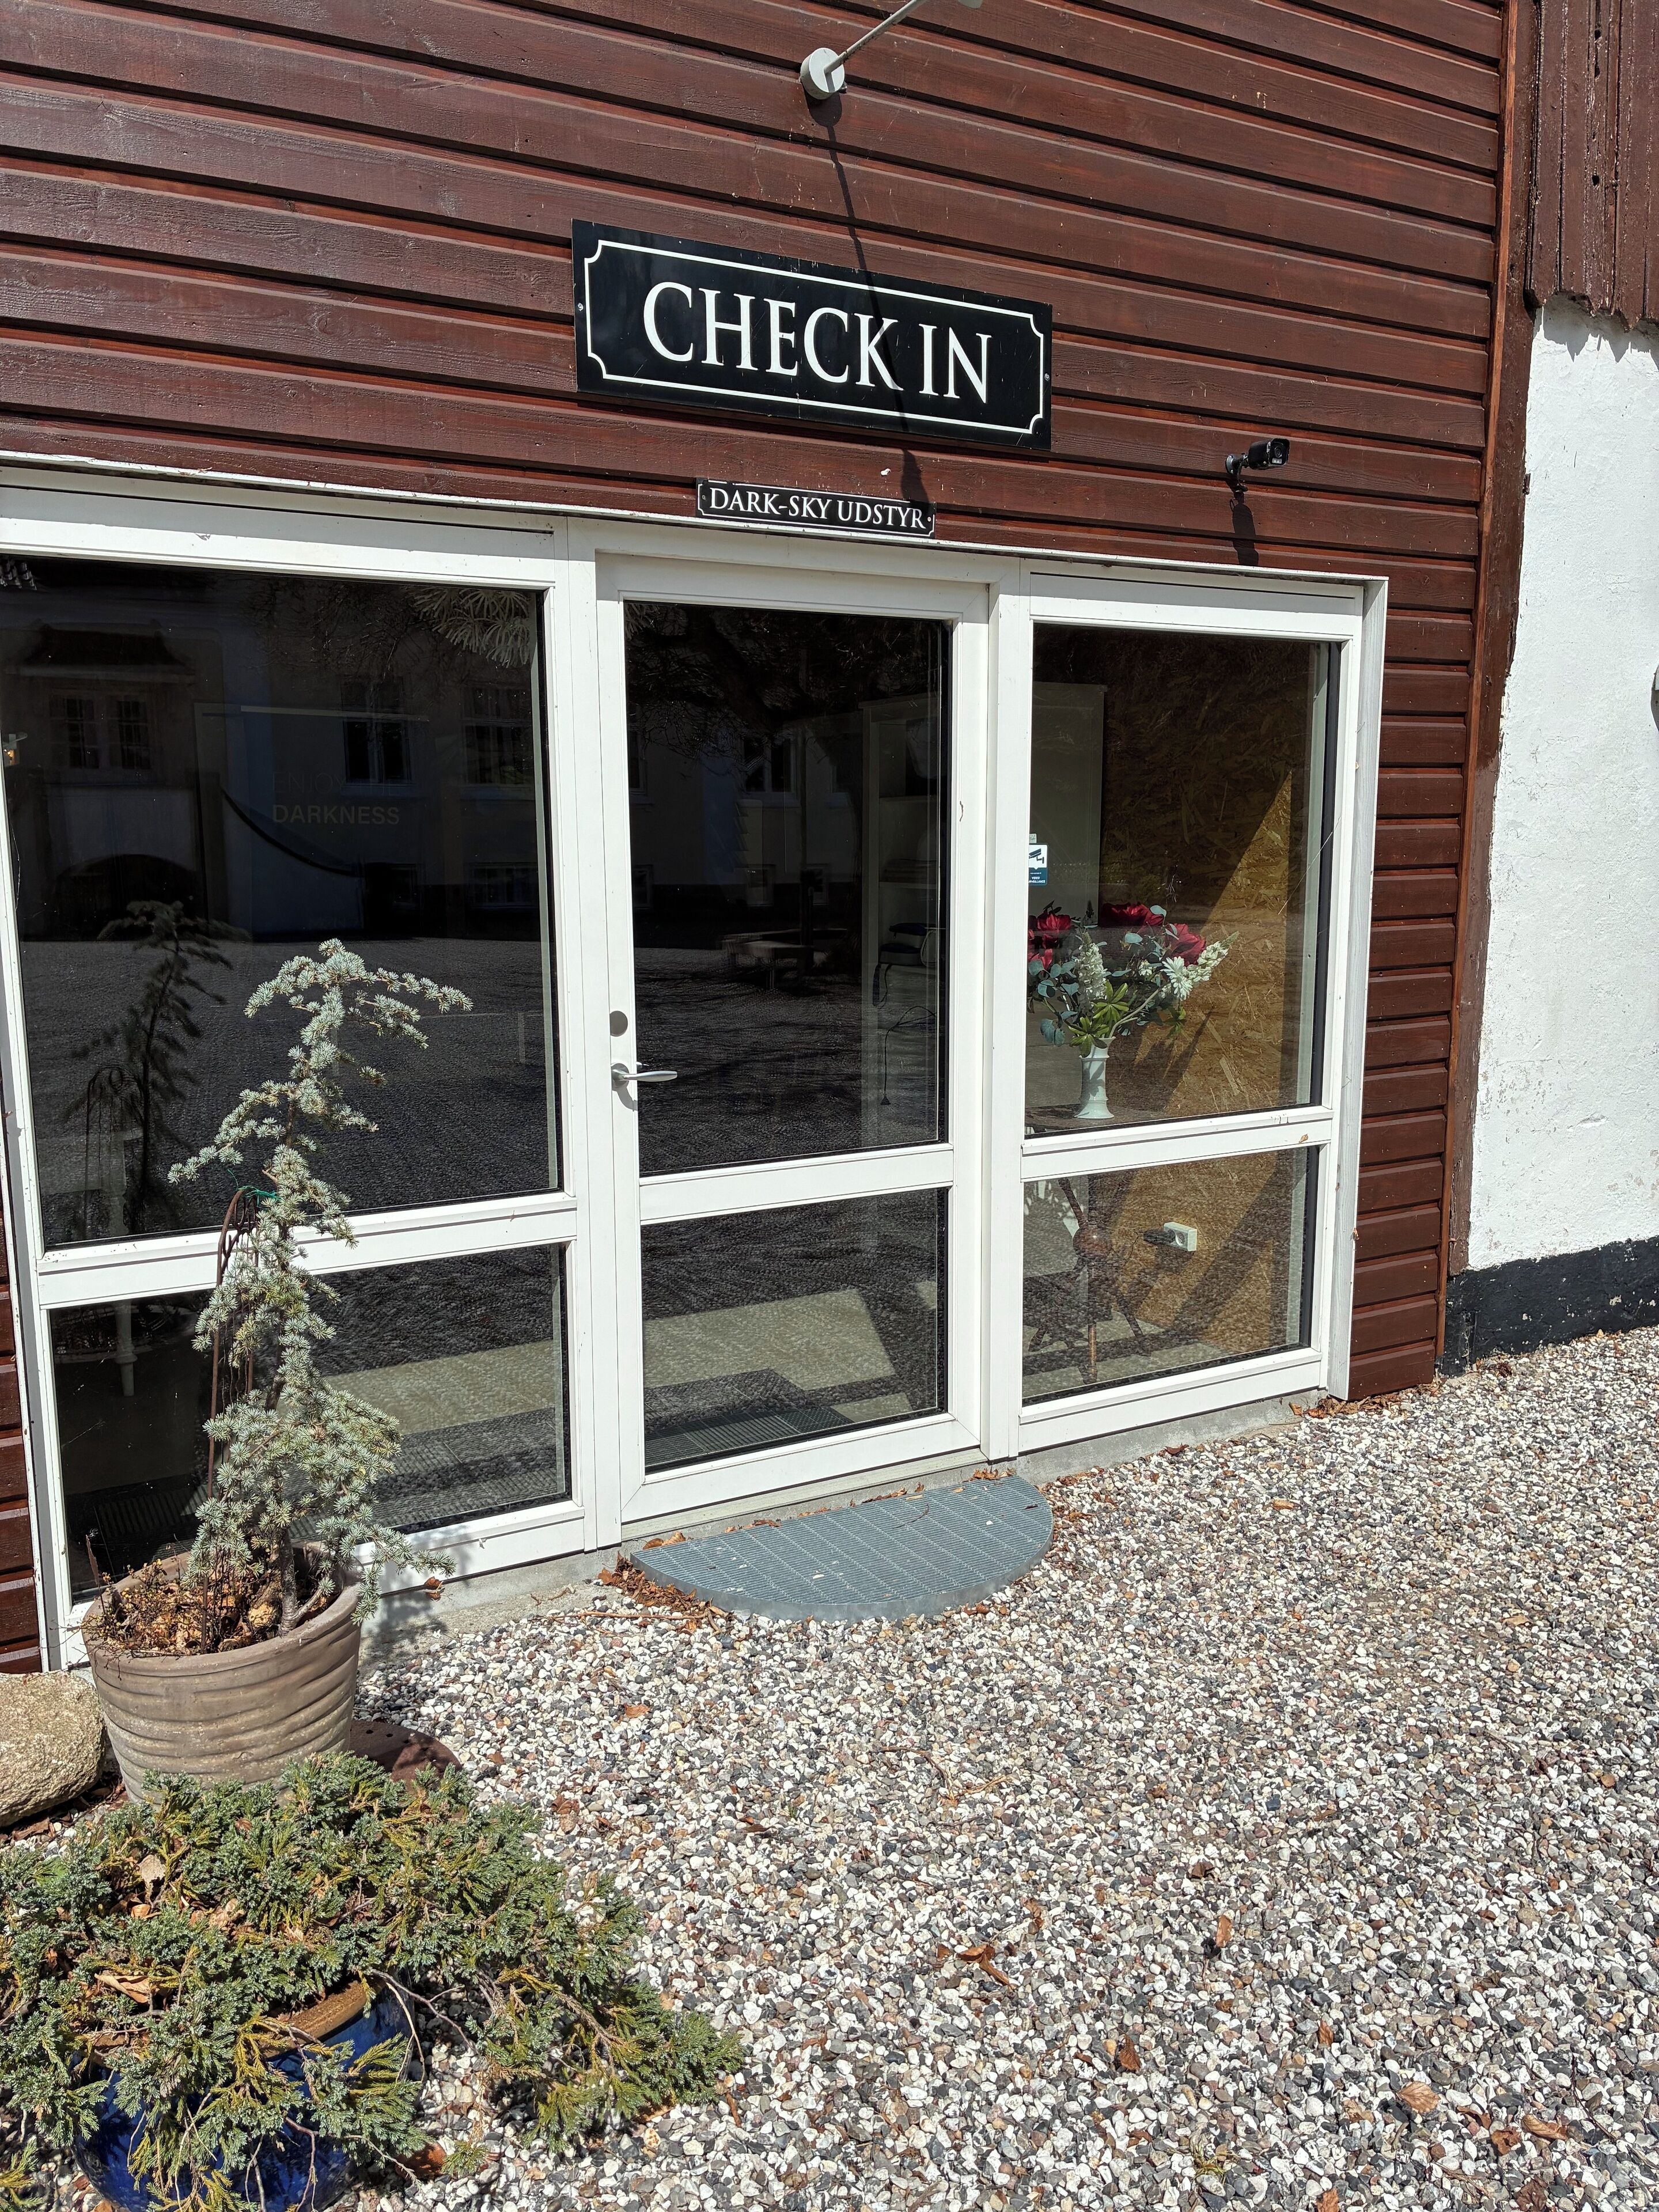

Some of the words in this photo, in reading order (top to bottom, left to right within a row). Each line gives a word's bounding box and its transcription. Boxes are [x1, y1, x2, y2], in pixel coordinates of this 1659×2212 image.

[643, 281, 904, 392] CHECK
[919, 323, 992, 404] IN
[709, 487, 833, 520] DARK-SKY
[836, 499, 926, 529] UDSTYR
[272, 804, 400, 824] DARKNESS
